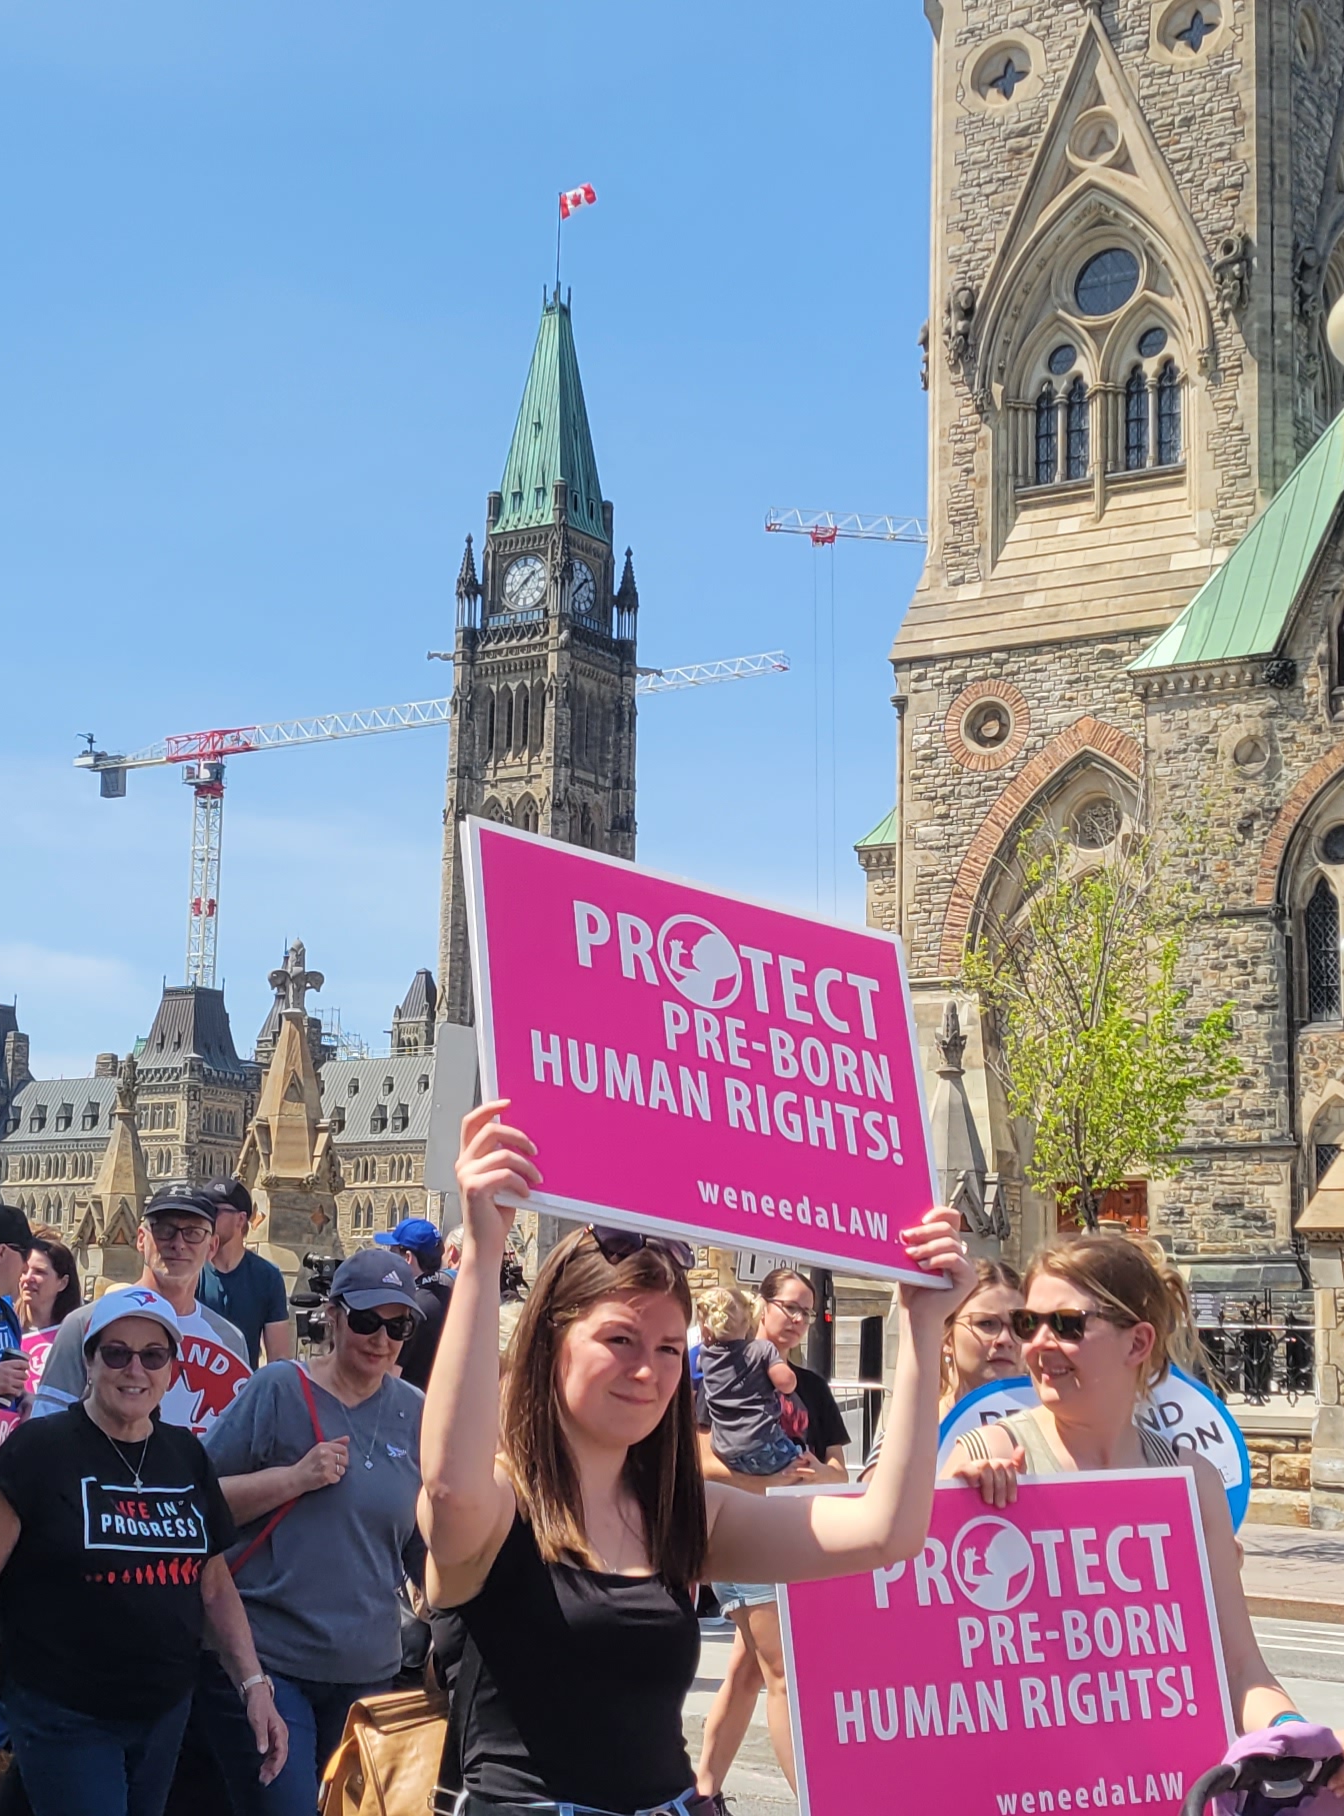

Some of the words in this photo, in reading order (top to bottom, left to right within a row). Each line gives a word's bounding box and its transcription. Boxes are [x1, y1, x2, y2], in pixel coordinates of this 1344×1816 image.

[662, 1000, 895, 1104] PRE-BORN
[530, 1028, 712, 1122] HUMAN
[723, 1076, 904, 1166] RIGHTS!
[100, 1513, 198, 1538] PROGRESS
[156, 1501, 178, 1518] IN
[957, 1602, 1187, 1669] PRE-BORN
[833, 1679, 1009, 1744] HUMAN
[1019, 1665, 1198, 1729] RIGHTS!
[996, 1771, 1184, 1816] weneedaLAW
